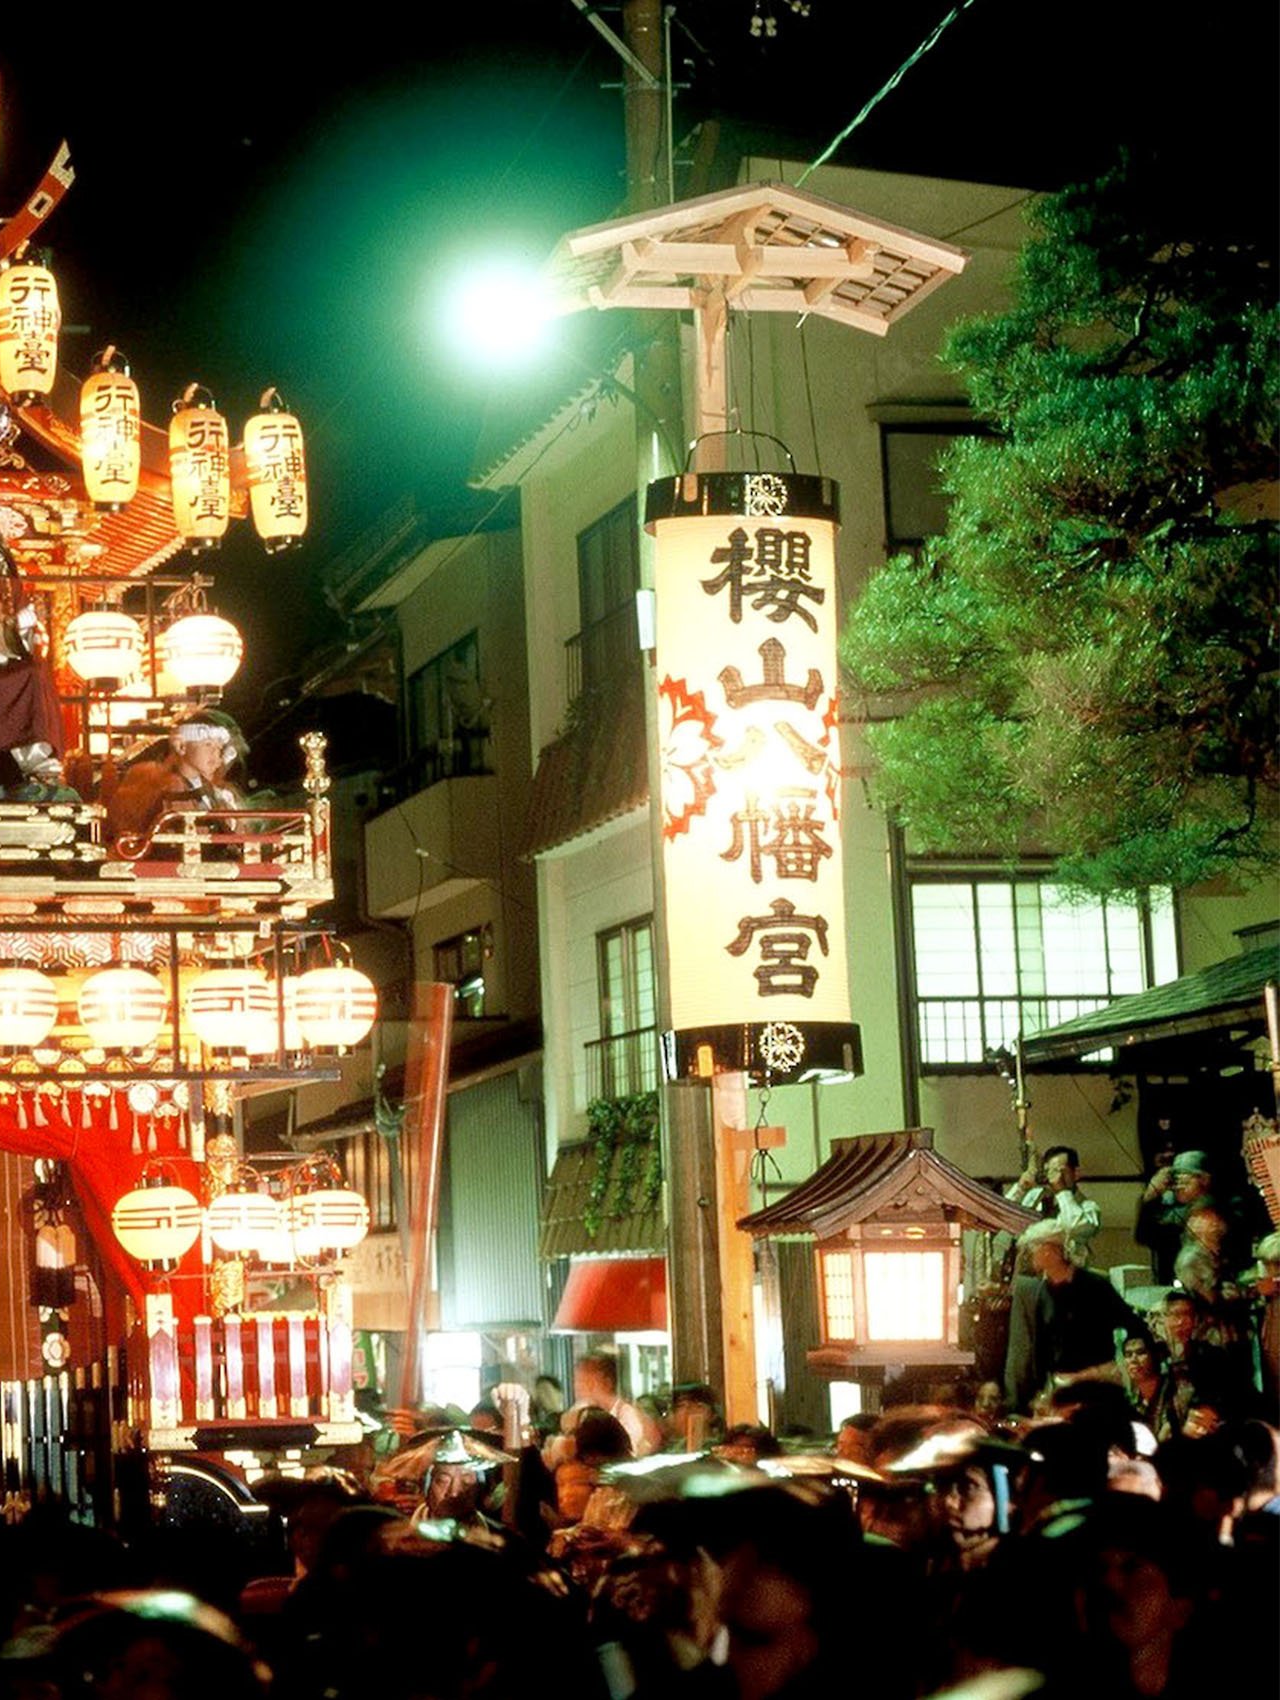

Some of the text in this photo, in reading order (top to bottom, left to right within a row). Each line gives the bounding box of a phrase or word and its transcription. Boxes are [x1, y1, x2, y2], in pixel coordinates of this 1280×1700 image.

[699, 525, 832, 1000] 櫻山八幡宮
